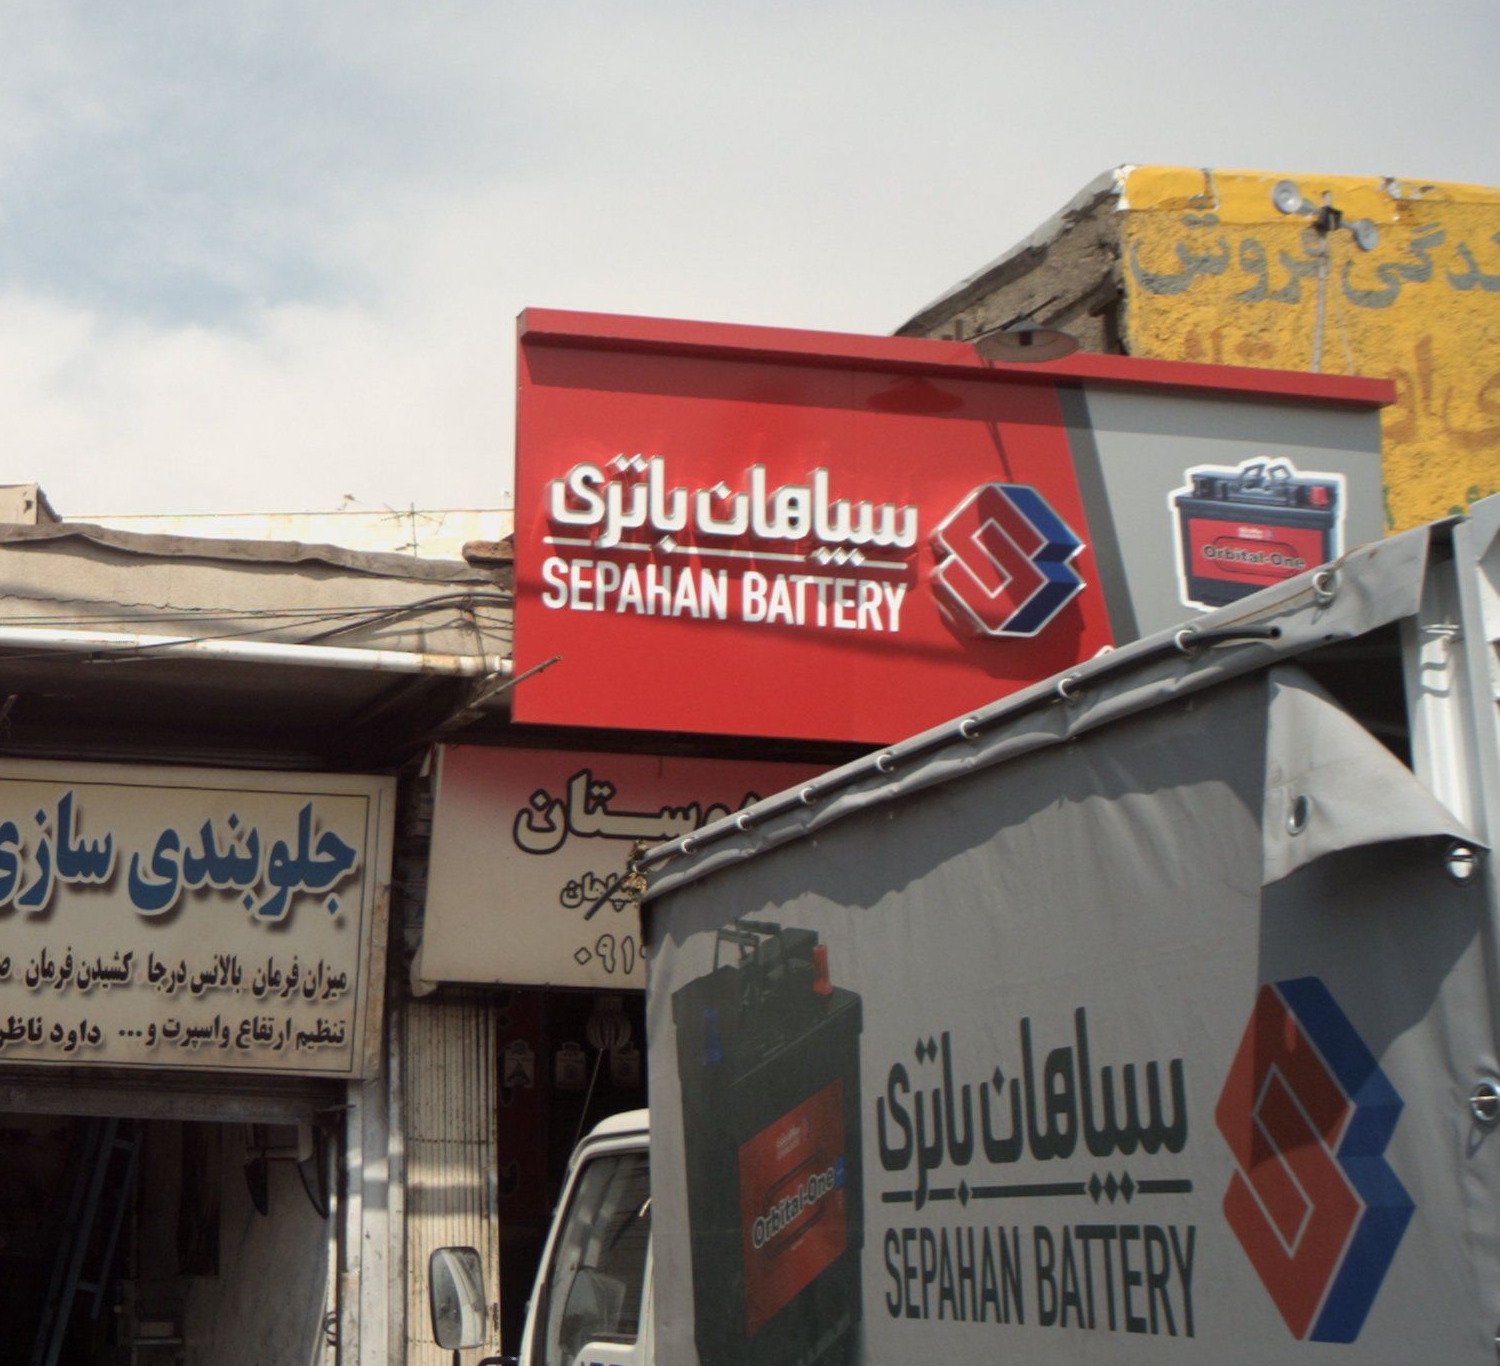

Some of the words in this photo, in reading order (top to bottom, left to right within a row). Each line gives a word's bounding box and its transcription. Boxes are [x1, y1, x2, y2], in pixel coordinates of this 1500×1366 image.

[549, 452, 688, 554] باتری
[695, 463, 918, 567] سپاهان
[1203, 544, 1306, 569] Orbital-One
[542, 556, 728, 621] SEPAHAN
[742, 570, 908, 633] BATTERY
[128, 801, 357, 916] جلوبندی
[25, 945, 73, 988] فرمان
[76, 950, 133, 989] کشیدن
[189, 953, 242, 994] بالانس
[252, 954, 300, 997] فرمان
[302, 958, 348, 999] میزان
[49, 1018, 101, 1052] داود
[235, 1015, 291, 1050] ارتفاع
[296, 1017, 346, 1050] تنظیم
[877, 1030, 974, 1211] باتری
[980, 1006, 1187, 1205] سپاهان
[752, 1166, 836, 1249] Orbital-One
[884, 1226, 1025, 1325] SEPAHAN
[1032, 1224, 1196, 1338] BATTERY
